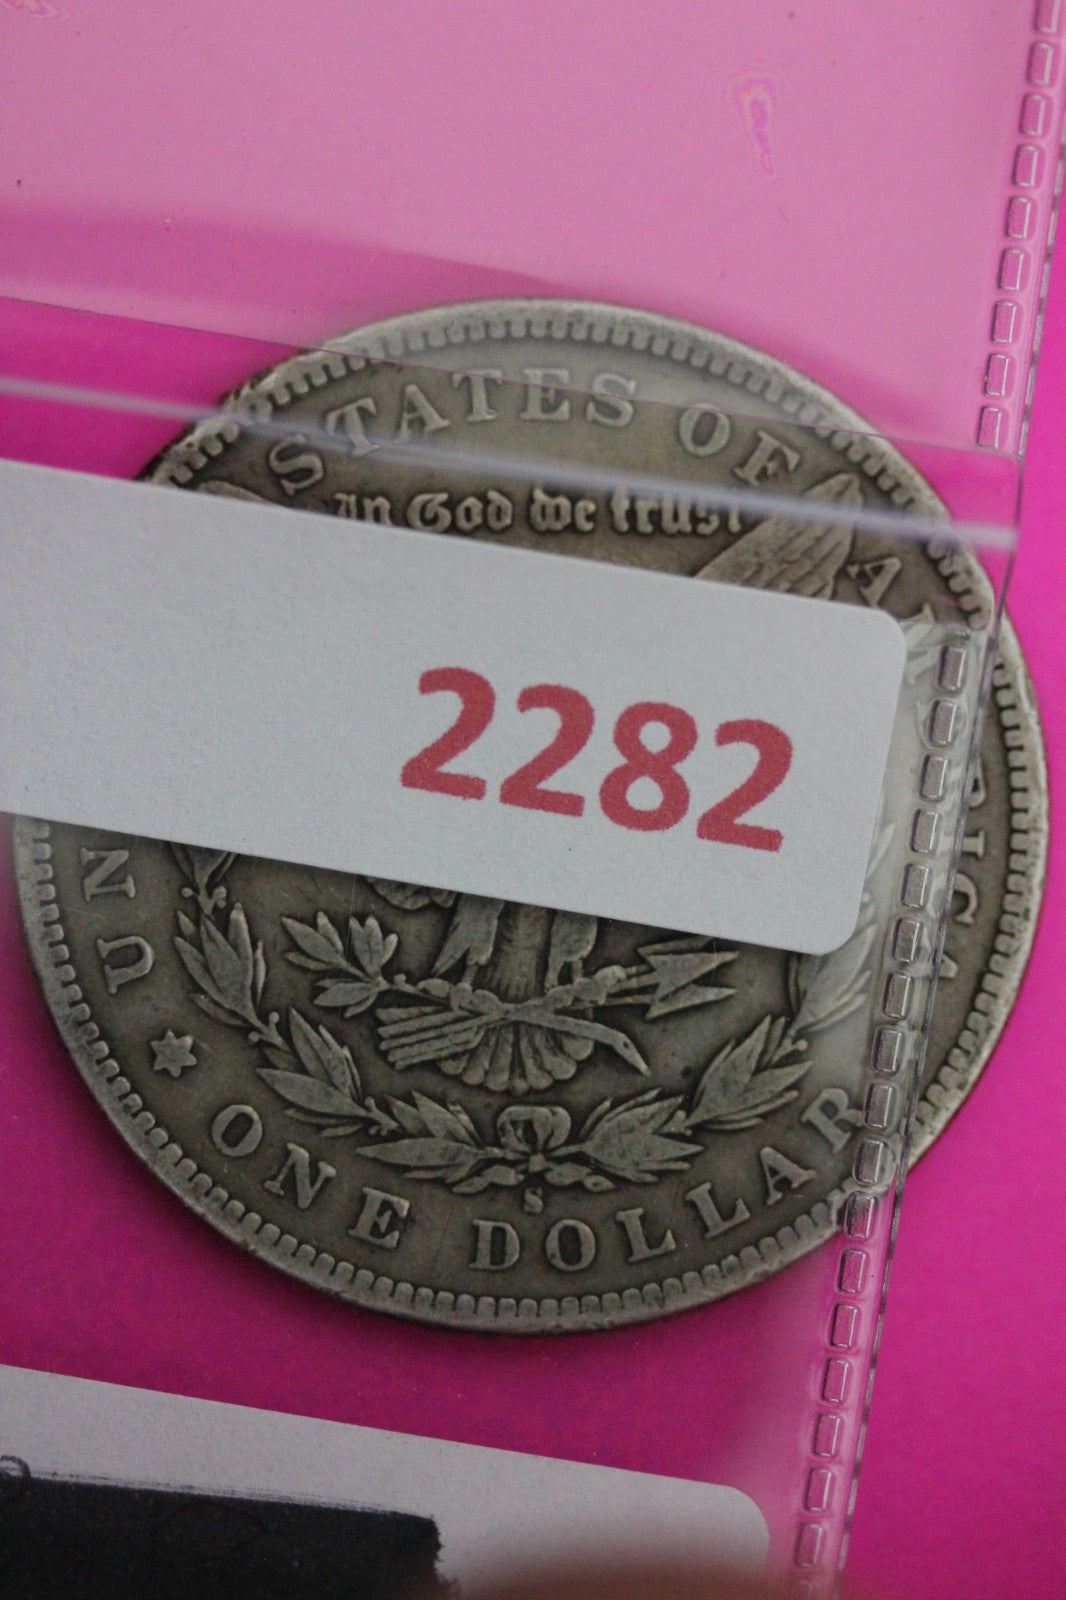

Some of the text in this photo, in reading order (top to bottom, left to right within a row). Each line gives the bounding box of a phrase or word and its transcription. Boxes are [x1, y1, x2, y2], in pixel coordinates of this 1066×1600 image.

[268, 367, 638, 496] STATES
[678, 403, 800, 486] OF
[406, 490, 514, 533] God
[529, 485, 597, 534] we
[400, 667, 793, 853] 2282
[212, 1087, 864, 1272] ONE DOLLAR
[523, 1186, 545, 1214] S
